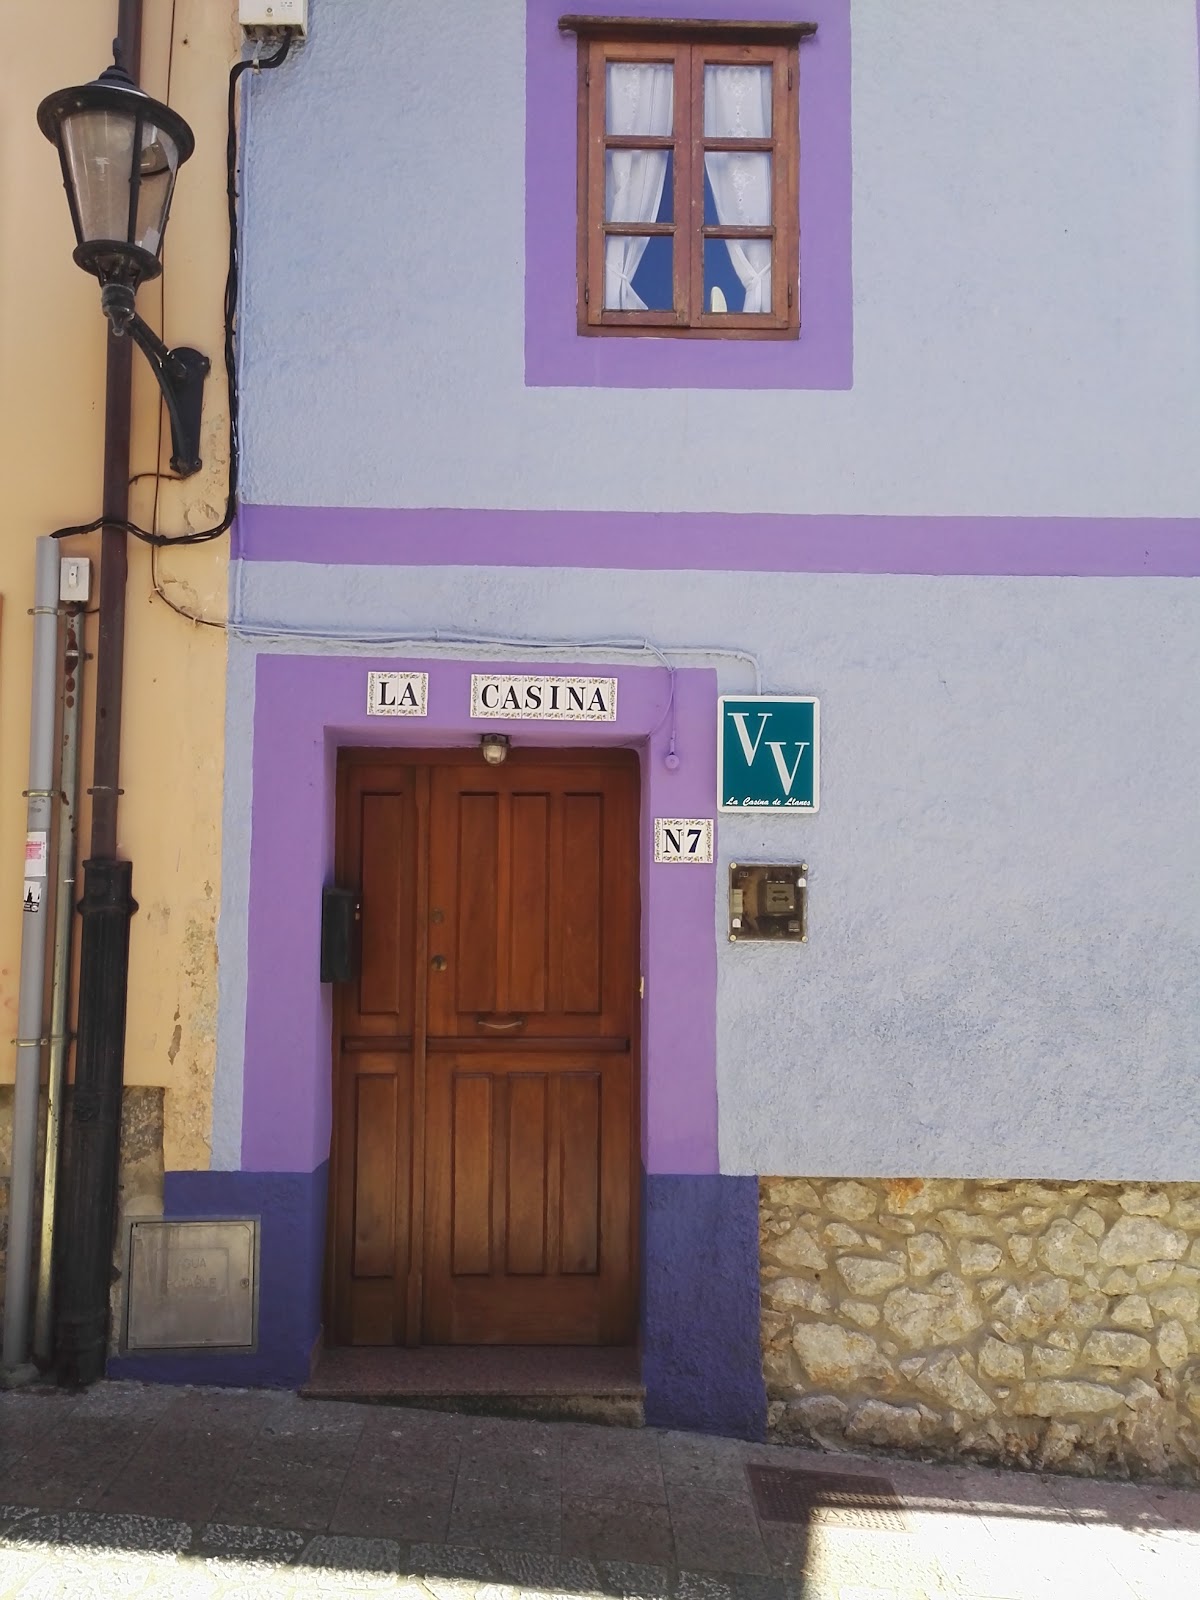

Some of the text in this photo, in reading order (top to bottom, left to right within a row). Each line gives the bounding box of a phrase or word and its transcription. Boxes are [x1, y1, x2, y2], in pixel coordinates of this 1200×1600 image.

[378, 681, 608, 712] LA CASINA
[725, 796, 812, 807] La Casina de Llanes
